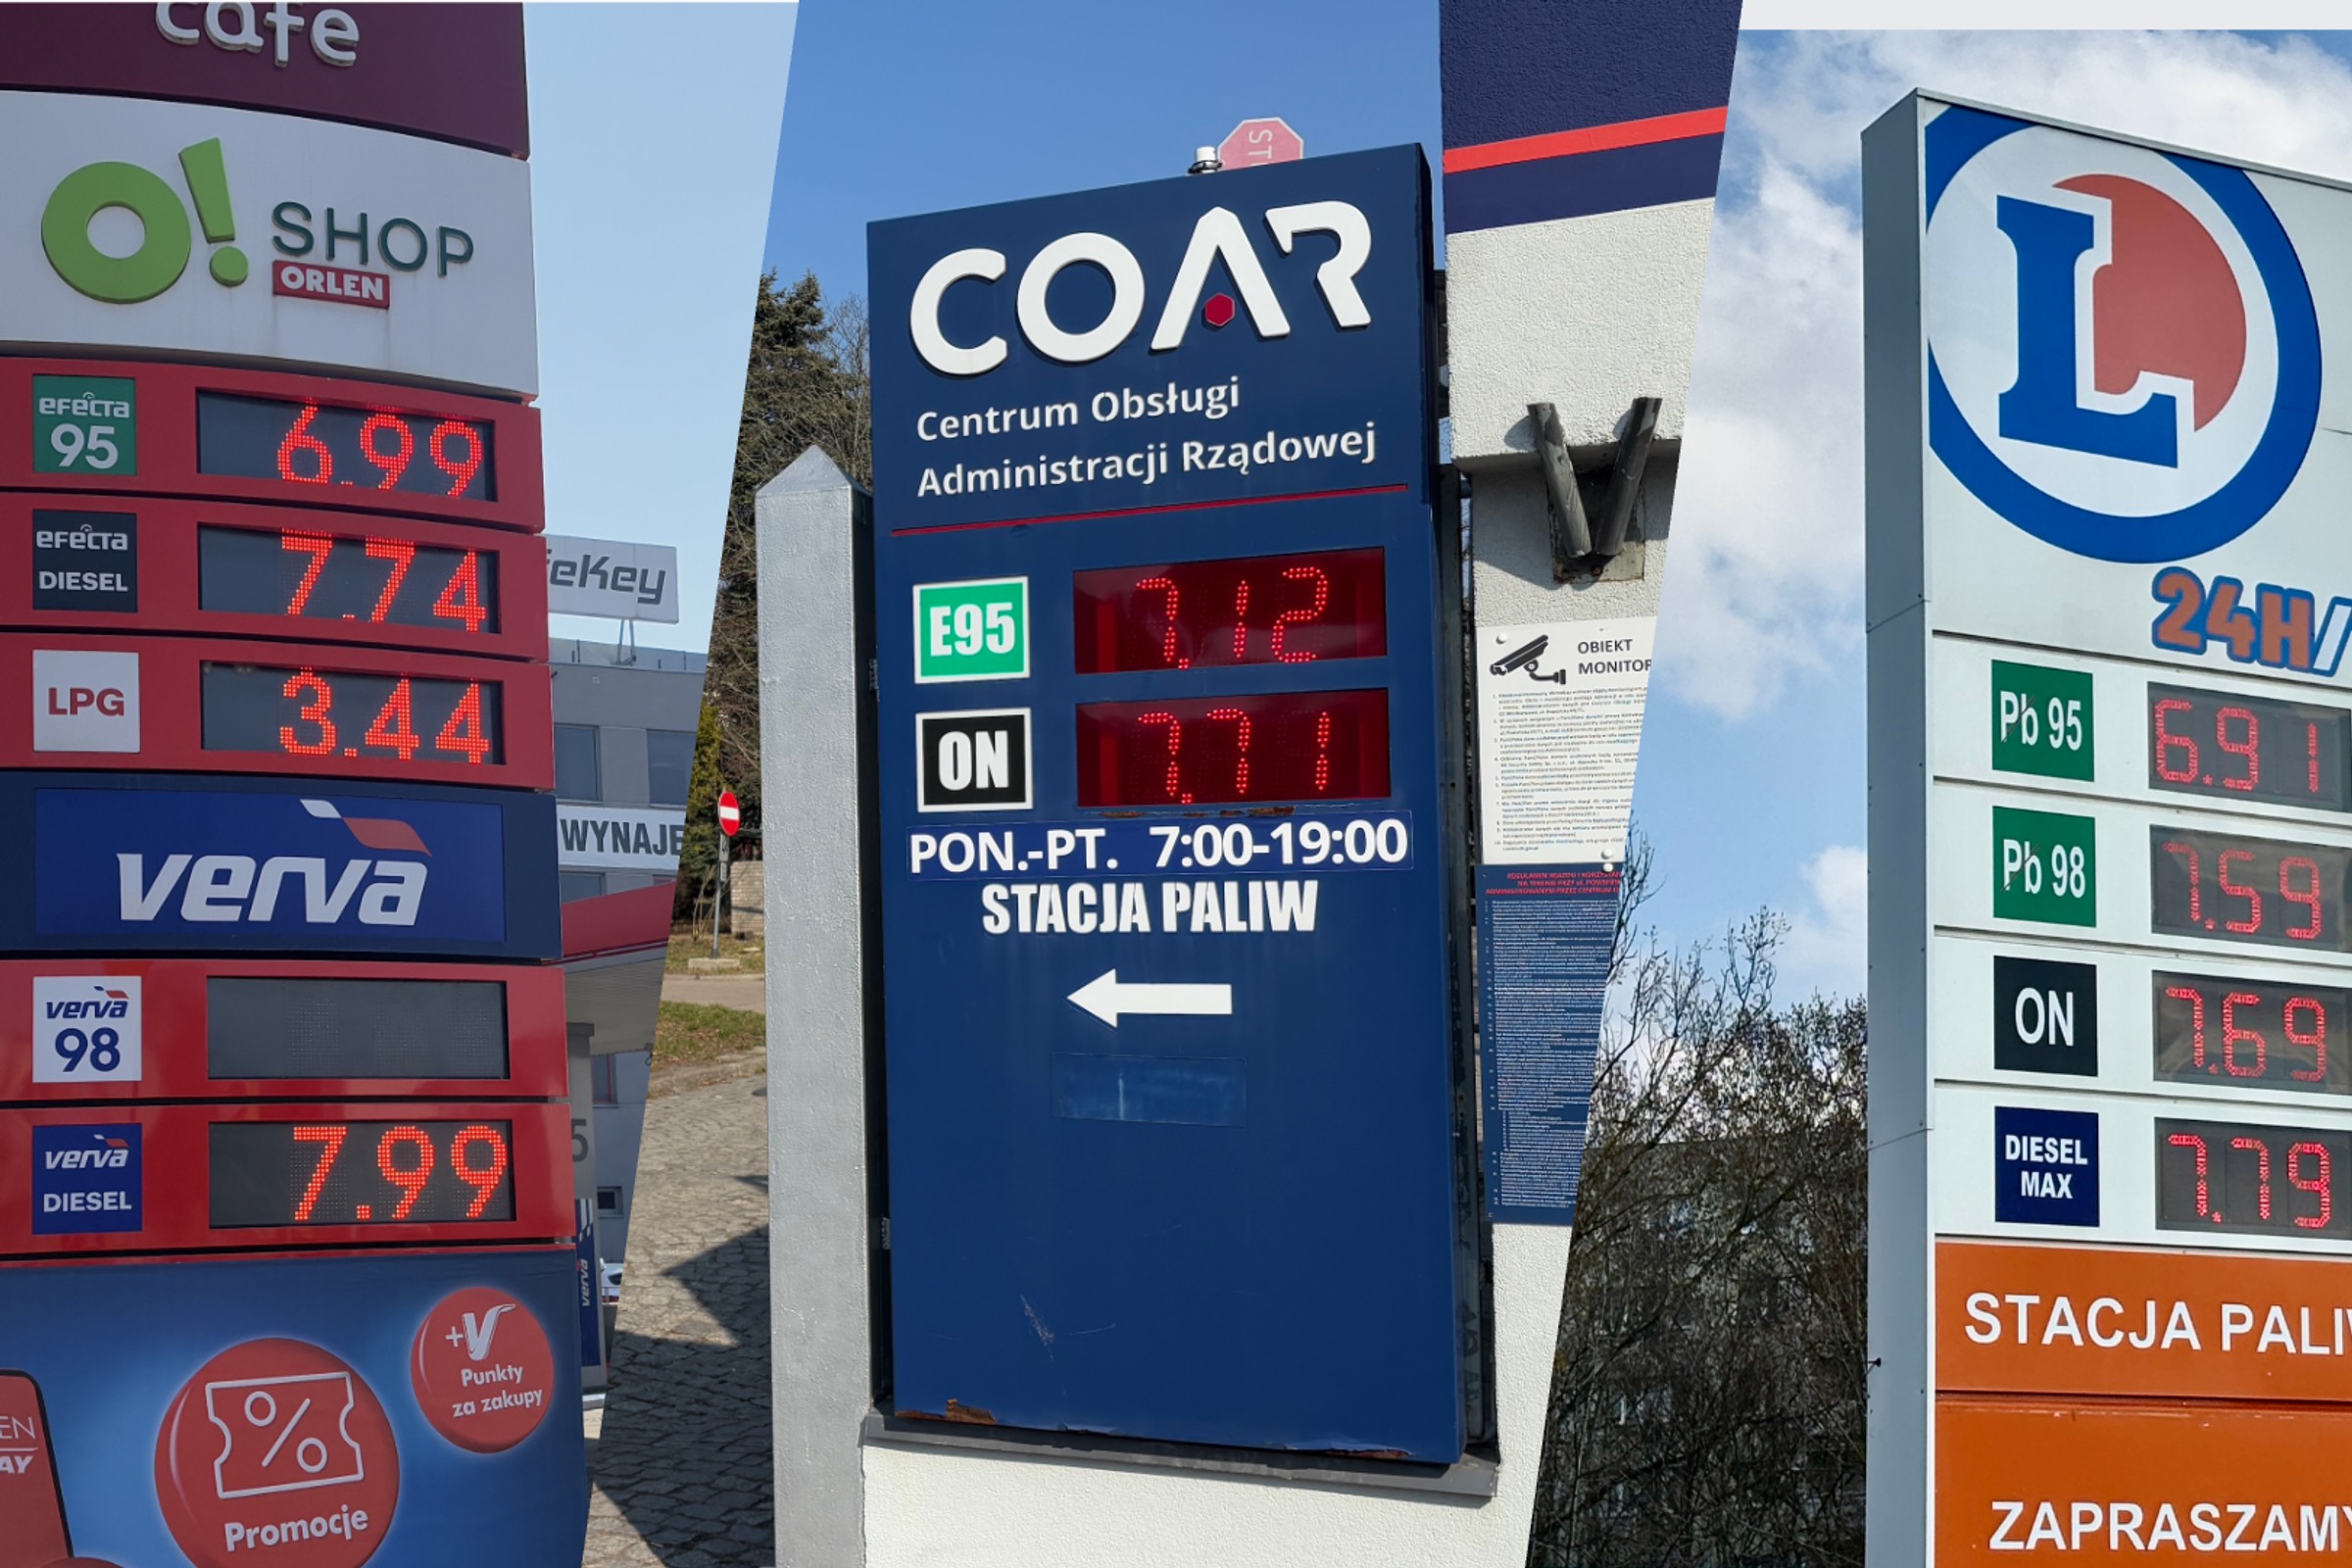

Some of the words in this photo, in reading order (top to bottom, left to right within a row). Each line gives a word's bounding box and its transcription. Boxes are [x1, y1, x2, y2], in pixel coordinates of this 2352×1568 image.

[1248, 128, 1273, 167] ST
[271, 202, 474, 277] SHOP
[280, 268, 384, 301] ORLEN
[909, 200, 1371, 375] COAR
[916, 399, 1079, 442] Centrum
[1092, 375, 1241, 423] Obsługi
[50, 423, 119, 469] 95
[276, 398, 484, 498] 6.99
[917, 442, 1168, 498] Administracji
[1183, 421, 1376, 476] Rządowej
[38, 570, 128, 592] DIESEL
[280, 527, 487, 632] 7.74
[547, 549, 666, 606] eKey
[929, 602, 1016, 656] E95
[1135, 565, 1328, 670] 7.12
[1577, 639, 1633, 654] OBIEKT
[48, 687, 125, 716] LPG
[279, 666, 490, 764] 3.44
[2000, 690, 2038, 746] Pb
[2047, 698, 2082, 752] 95
[938, 729, 1009, 791] ON
[1138, 707, 1332, 805] 7.71
[2154, 699, 2318, 793] 6.91
[910, 827, 1118, 874] PON.-PT.
[1150, 818, 1407, 869] 7:00-19:00
[2002, 838, 2042, 893] Pb
[2051, 844, 2086, 898] 98
[116, 852, 430, 927] verva
[982, 881, 1152, 935] STACJA
[1162, 879, 1319, 933] PALIW
[2162, 840, 2322, 940] 7.59
[46, 1001, 129, 1019] verva
[2015, 987, 2075, 1046] ON
[2165, 986, 2328, 1082] 7.69
[55, 1027, 121, 1072] 98
[45, 1149, 129, 1169] verva
[292, 1124, 509, 1222] 7.99
[2005, 1133, 2088, 1166] DIESEL
[43, 1191, 132, 1212] DIESEL
[2021, 1171, 2073, 1200] MAX
[2167, 1133, 2331, 1229] 7.79
[1964, 1292, 2202, 1350] STACJA
[2220, 1302, 2352, 1356] PALI
[452, 1401, 476, 1418] za
[481, 1389, 543, 1412] zakupy
[461, 1363, 523, 1387] Punkty
[224, 1503, 369, 1552] Promocje
[1989, 1500, 2352, 1552] ZAPRASZAM
